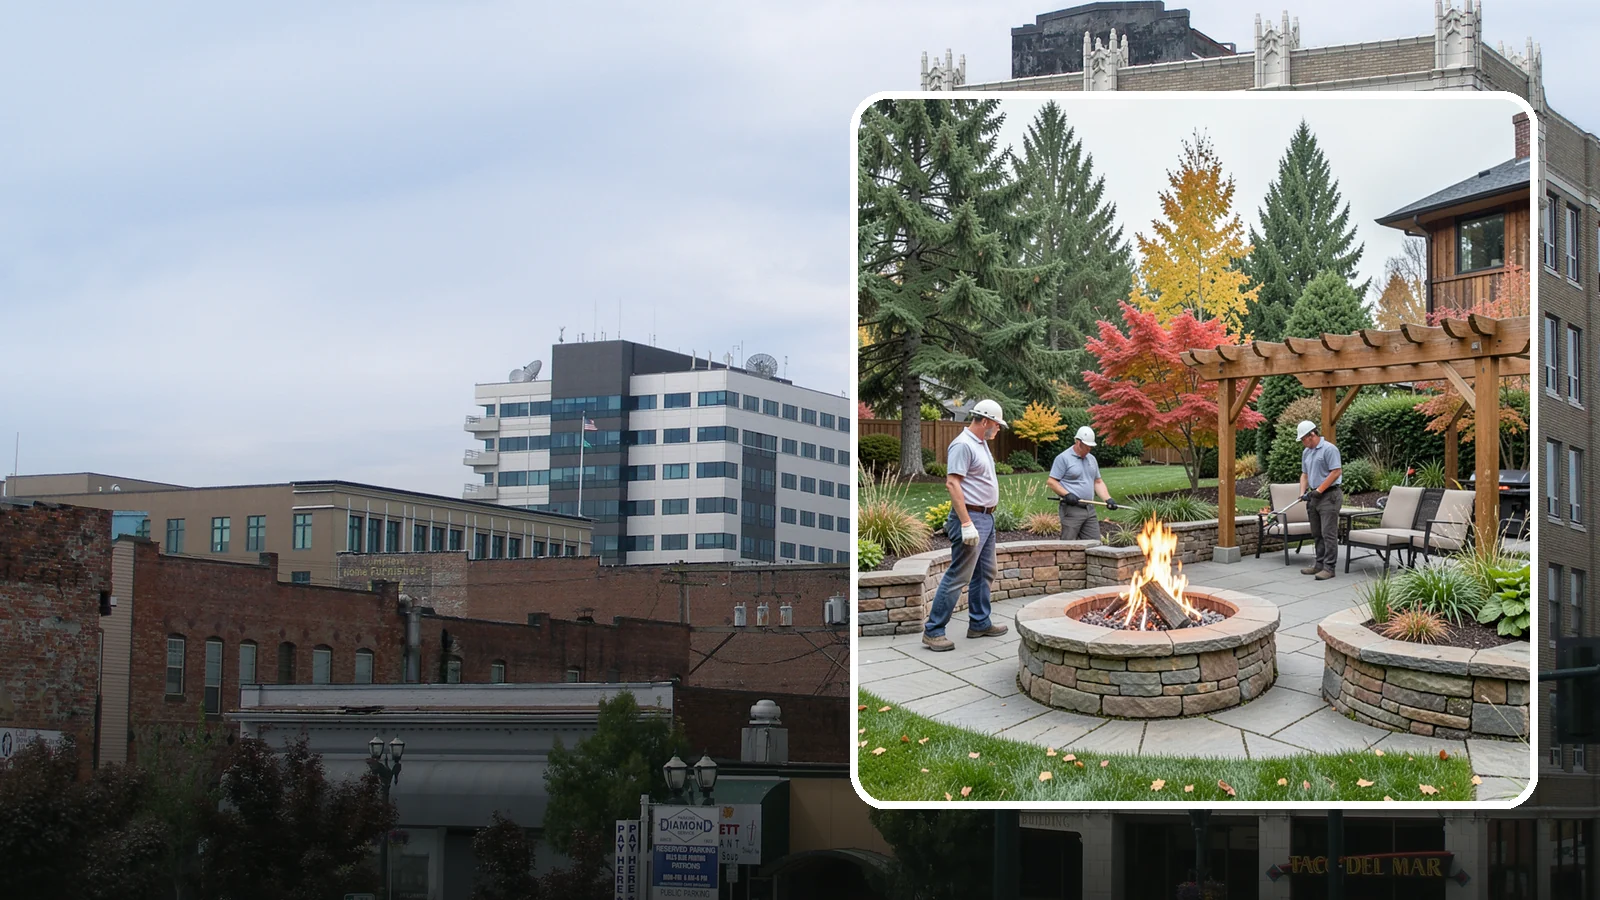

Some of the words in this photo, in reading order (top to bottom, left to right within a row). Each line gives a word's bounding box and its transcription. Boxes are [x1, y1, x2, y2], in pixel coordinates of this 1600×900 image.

[343, 568, 368, 577] Home
[370, 566, 427, 577] Furnishers
[660, 818, 713, 833] DIAMOND
[1022, 815, 1069, 827] BUILDING
[617, 825, 625, 853] PAY
[628, 824, 637, 852] PAY
[656, 845, 688, 853] RESERVED
[689, 846, 716, 854] PARKING
[721, 851, 739, 862] Soup
[671, 862, 701, 870] PATRONS
[1346, 856, 1385, 875] DEL
[1392, 857, 1443, 877] MAR
[616, 855, 625, 894] HERE
[627, 855, 636, 894] HERE
[660, 888, 682, 897] PUBLIC
[683, 889, 710, 898] PARKING
